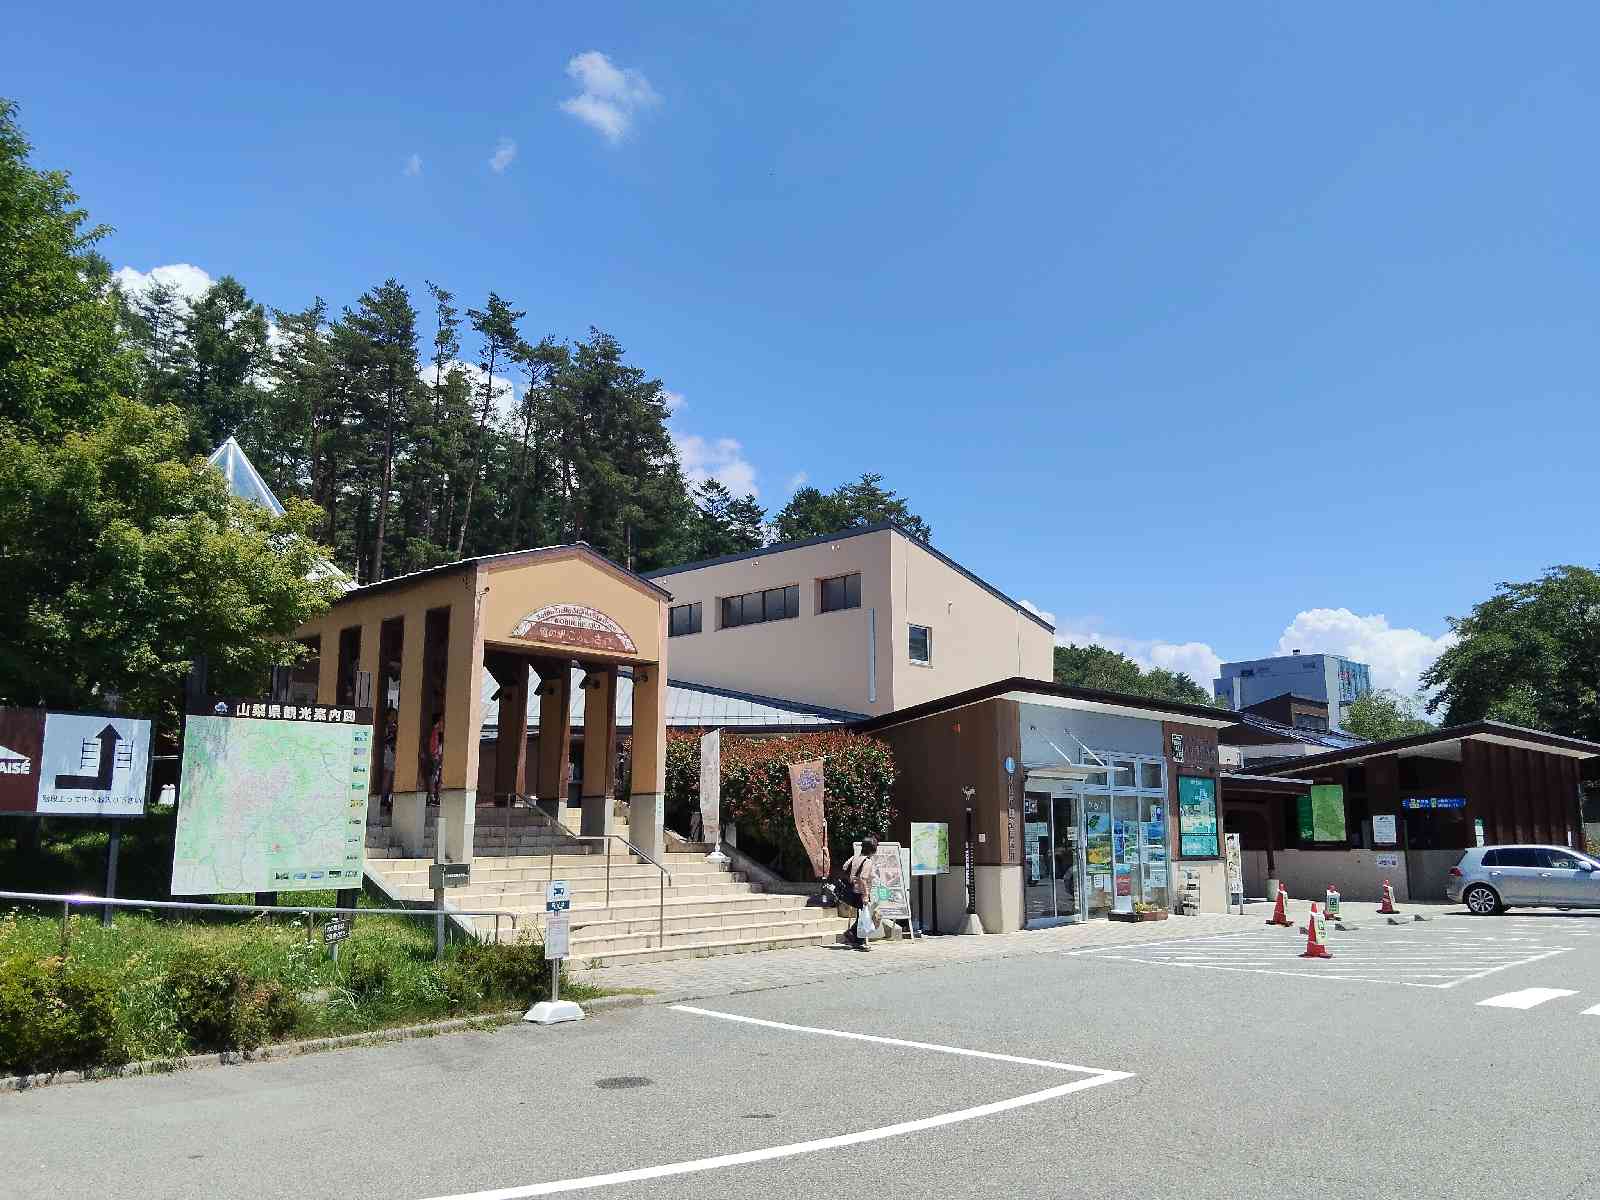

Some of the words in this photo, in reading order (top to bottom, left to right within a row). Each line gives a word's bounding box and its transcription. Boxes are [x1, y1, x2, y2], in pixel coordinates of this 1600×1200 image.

[236, 702, 356, 722] 山梨県観光案内図
